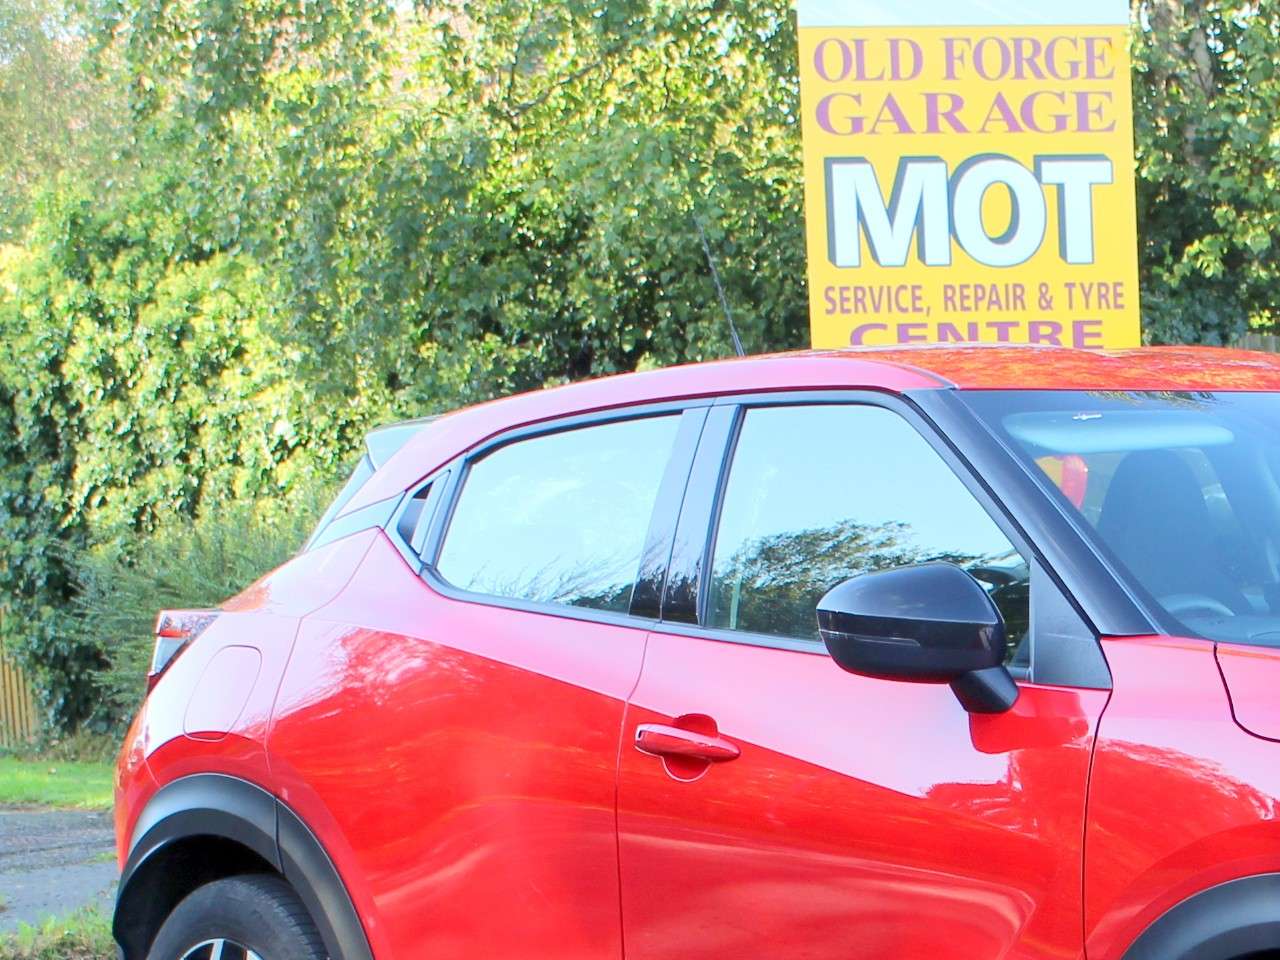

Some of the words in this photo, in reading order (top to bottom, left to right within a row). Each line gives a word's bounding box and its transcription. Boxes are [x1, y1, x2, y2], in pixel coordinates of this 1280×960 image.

[813, 37, 924, 82] OLD
[940, 36, 1116, 81] FORGE
[814, 91, 1117, 136] GARAGE
[824, 152, 1114, 269] MOT
[823, 285, 932, 317] SERVICE,
[943, 284, 1027, 313] REPAIR
[1037, 282, 1054, 312] &
[1064, 281, 1126, 311] TYRE
